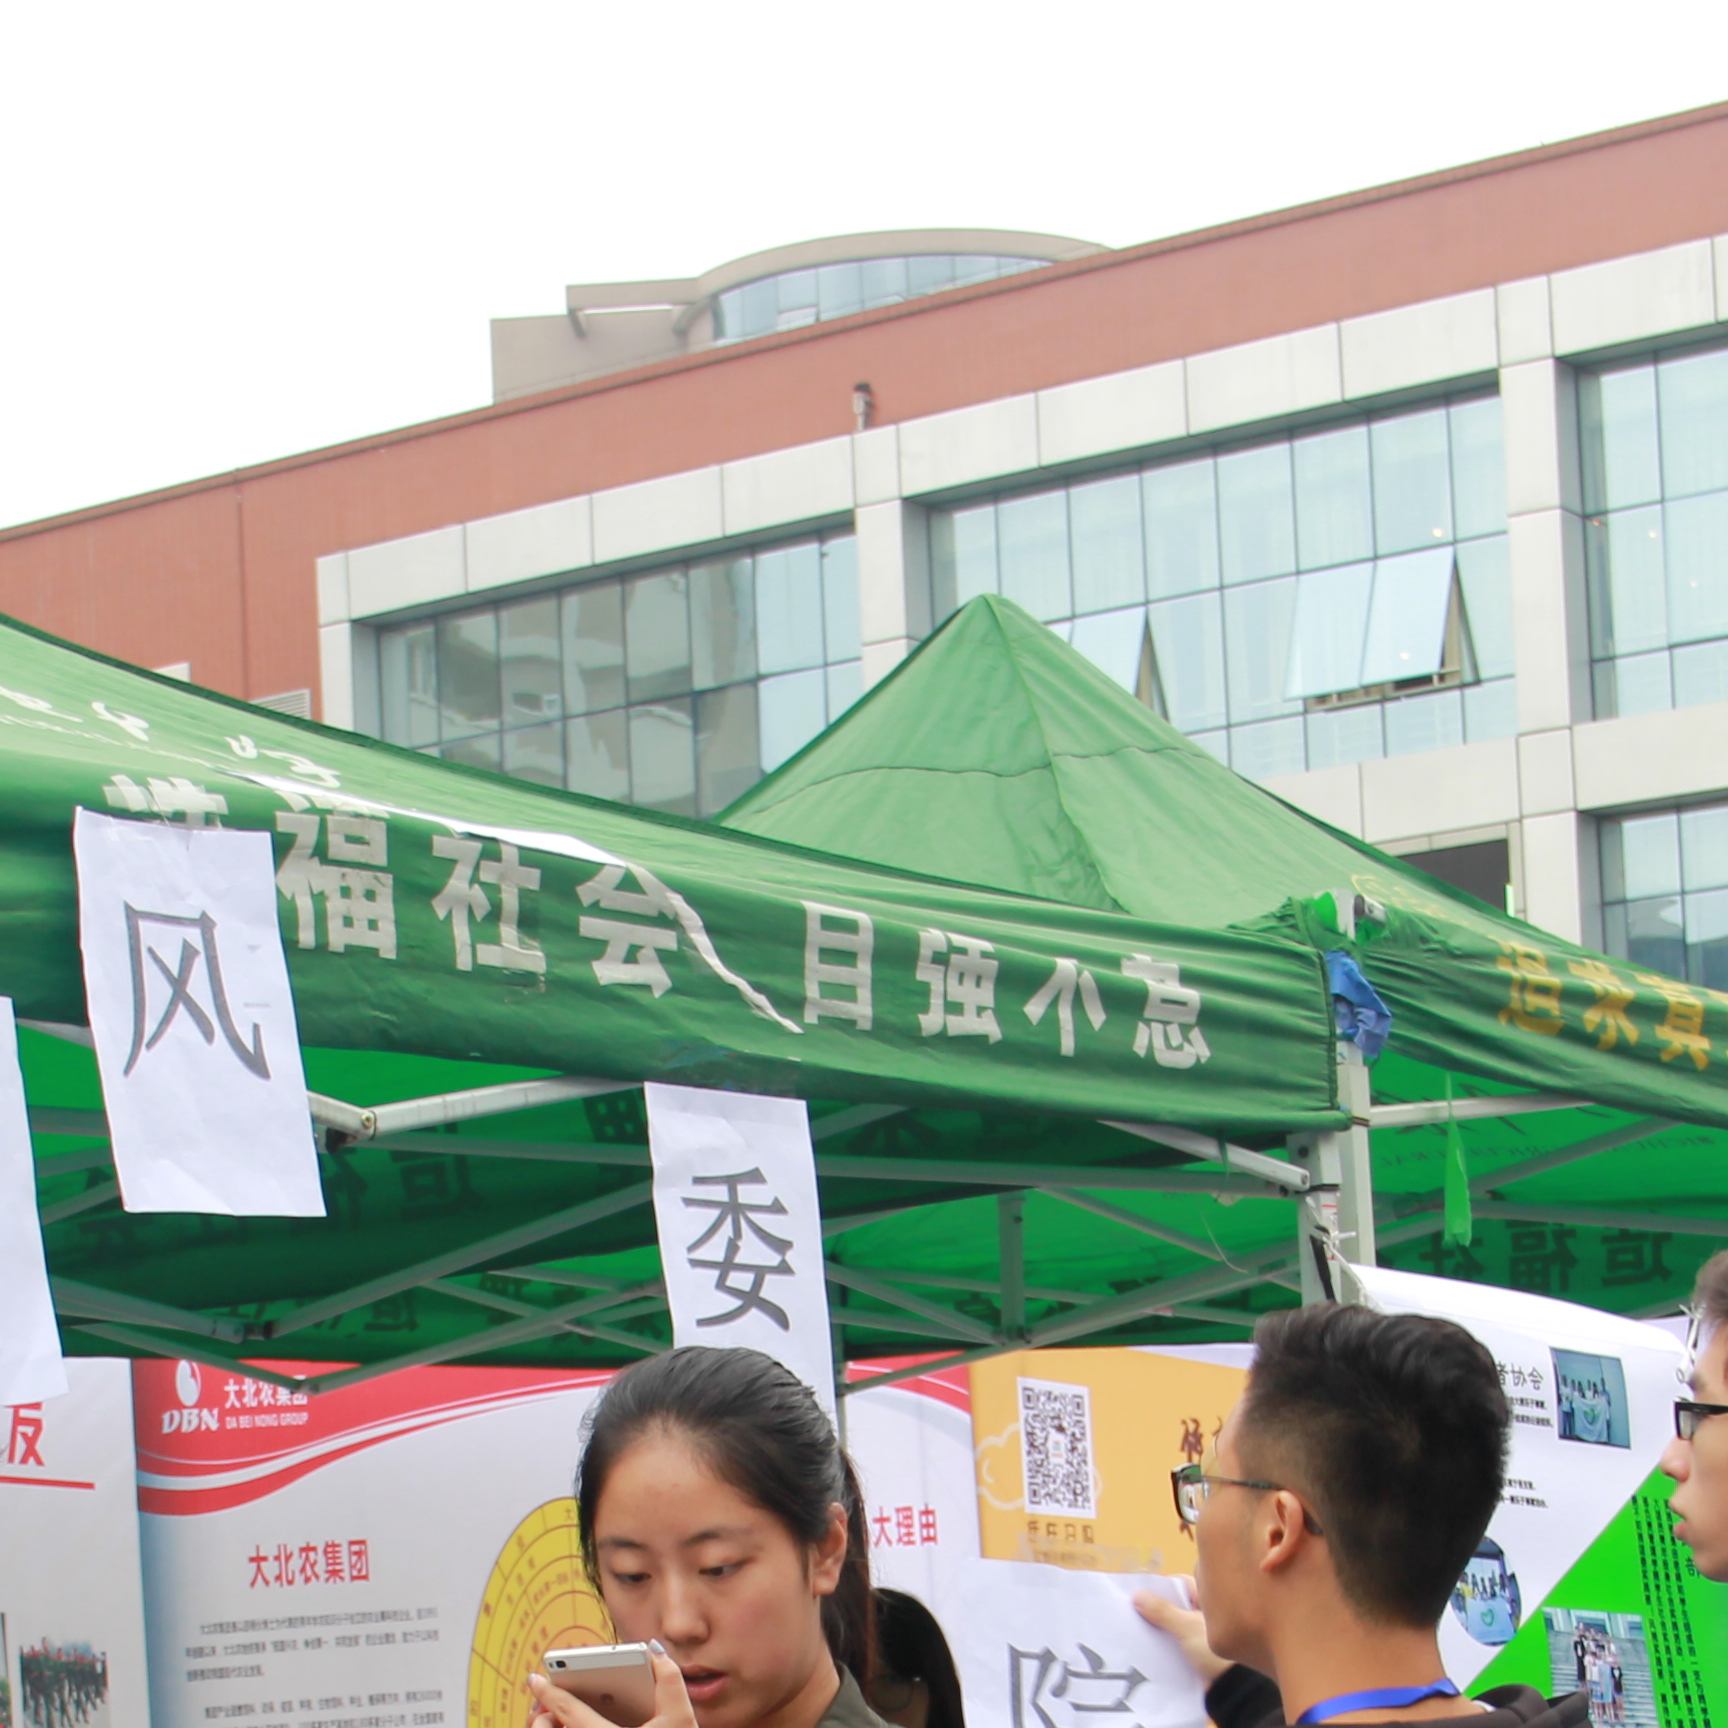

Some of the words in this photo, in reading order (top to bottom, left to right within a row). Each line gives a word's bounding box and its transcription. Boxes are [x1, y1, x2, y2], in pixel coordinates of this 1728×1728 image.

[124, 901, 271, 1080] 风
[681, 1166, 795, 1331] 委
[161, 1408, 219, 1434] DBN
[872, 1502, 939, 1548] 大理由
[248, 1539, 371, 1590] 大北农集团
